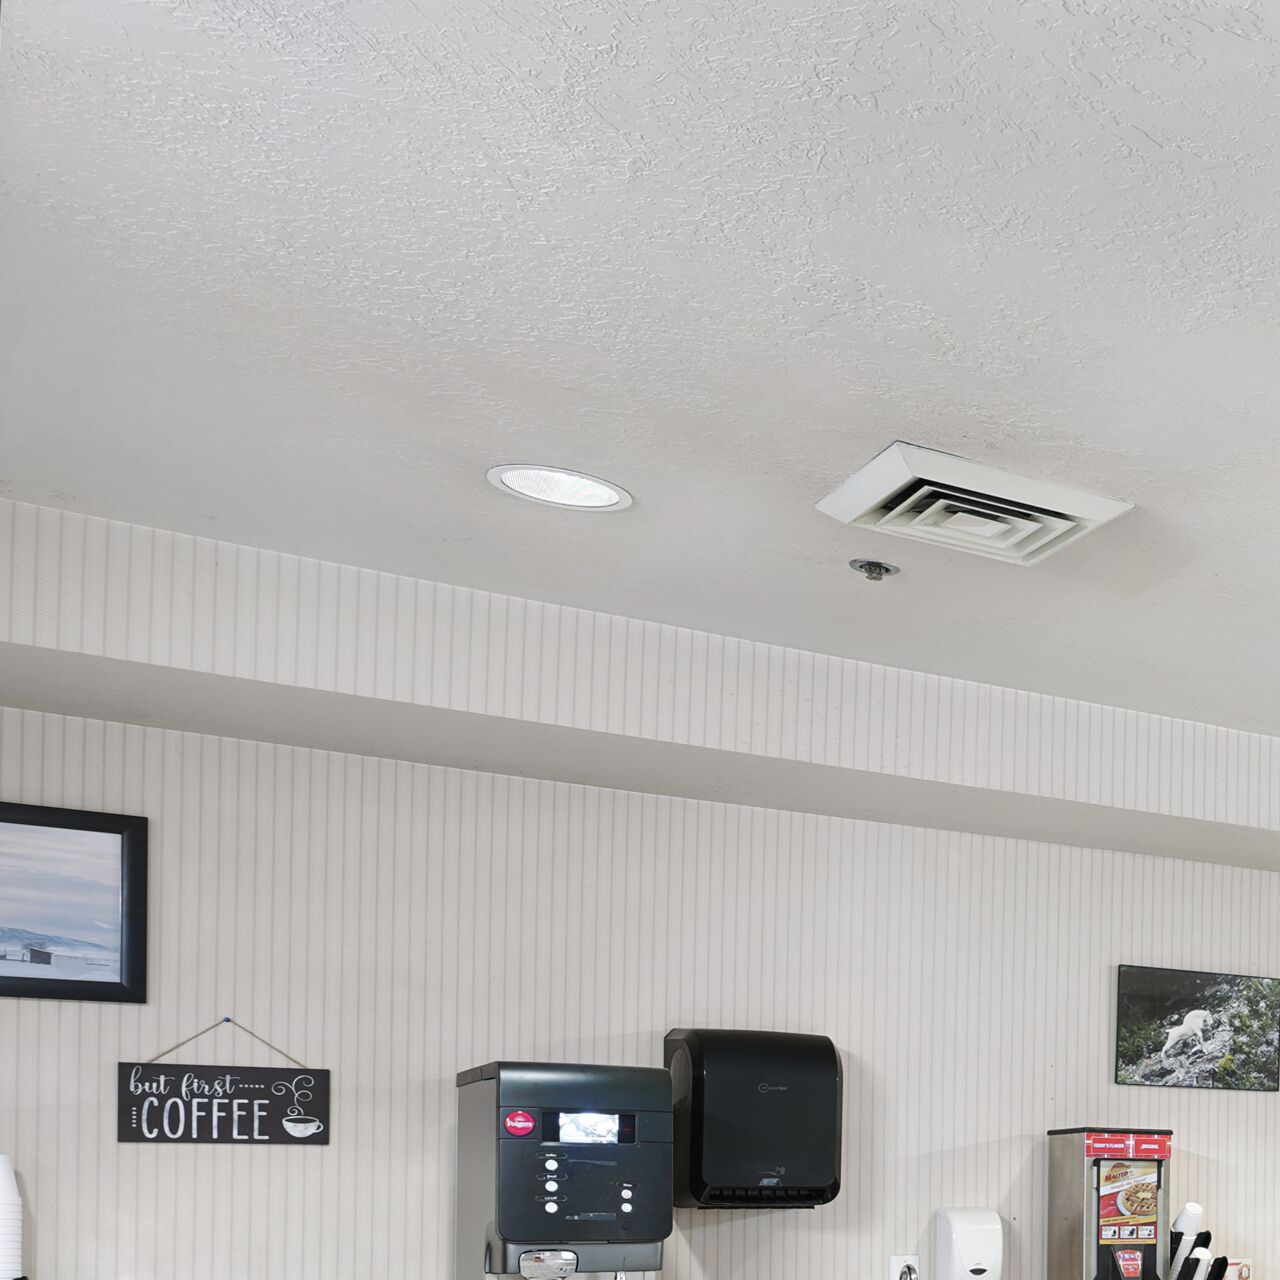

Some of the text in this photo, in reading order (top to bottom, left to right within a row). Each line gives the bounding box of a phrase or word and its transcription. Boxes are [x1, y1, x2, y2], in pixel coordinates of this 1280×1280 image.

[129, 1065, 241, 1101] but first
[141, 1096, 270, 1140] COFFEE
[506, 1117, 534, 1128] Folgers
